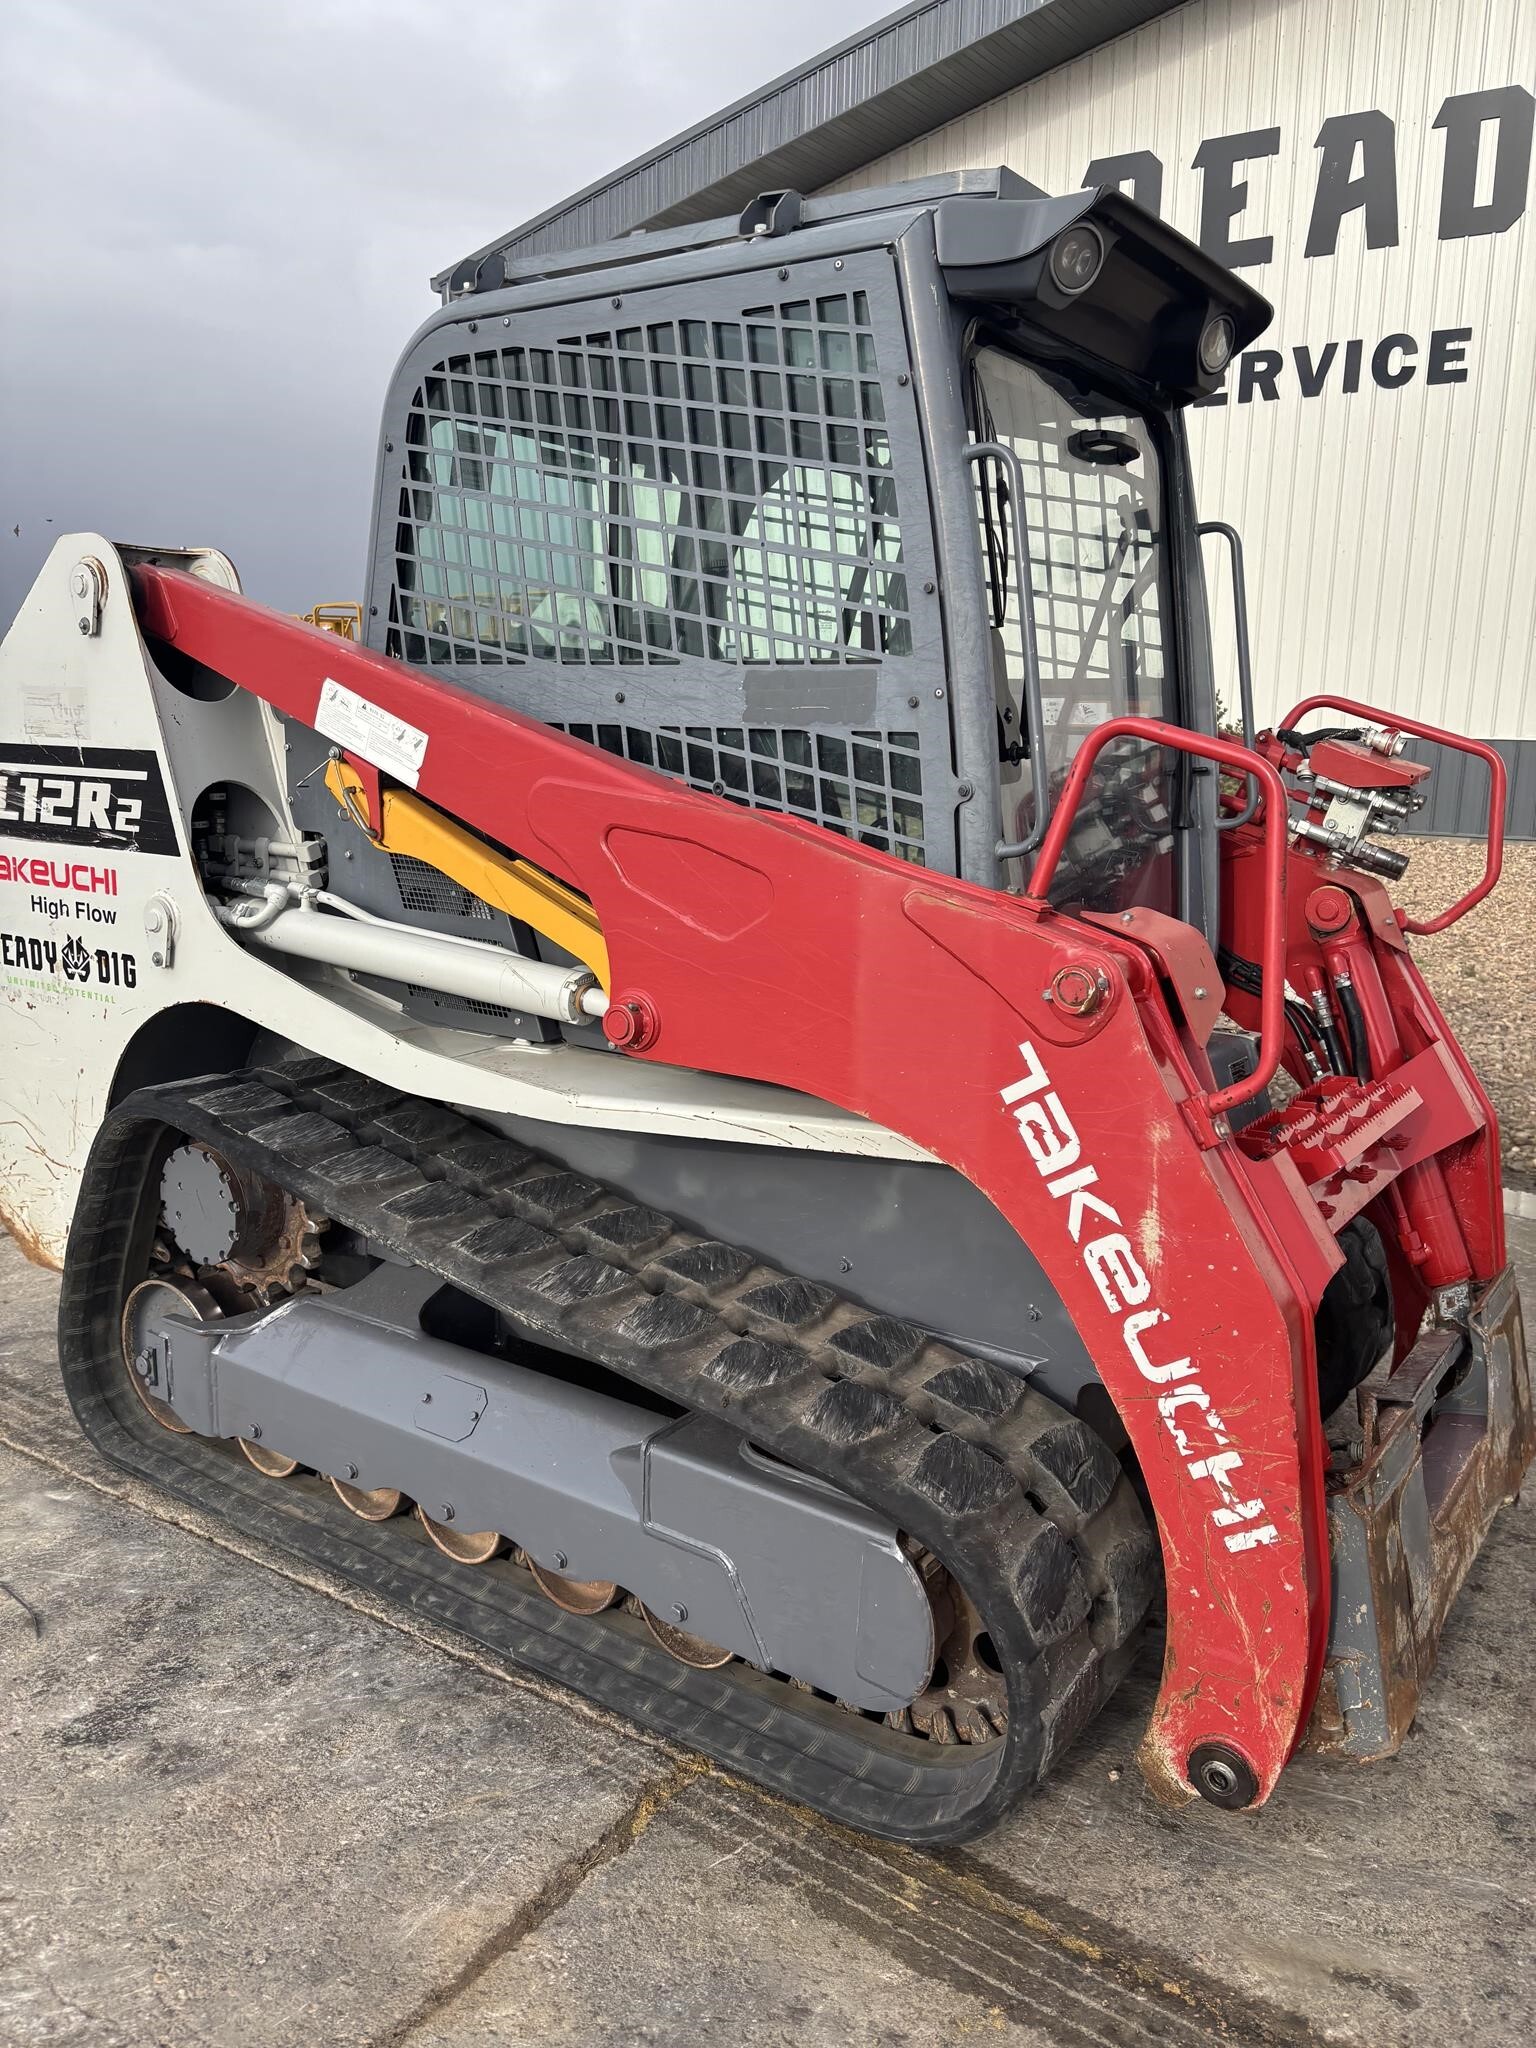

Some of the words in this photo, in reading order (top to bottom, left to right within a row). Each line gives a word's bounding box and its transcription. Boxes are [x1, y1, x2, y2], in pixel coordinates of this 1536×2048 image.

[1193, 327, 1473, 409] RVICE
[31, 894, 69, 919] High
[75, 901, 117, 925] Flow
[1, 933, 57, 974] EADY
[94, 949, 137, 989] DIG
[62, 985, 117, 1005] POTENTIAL
